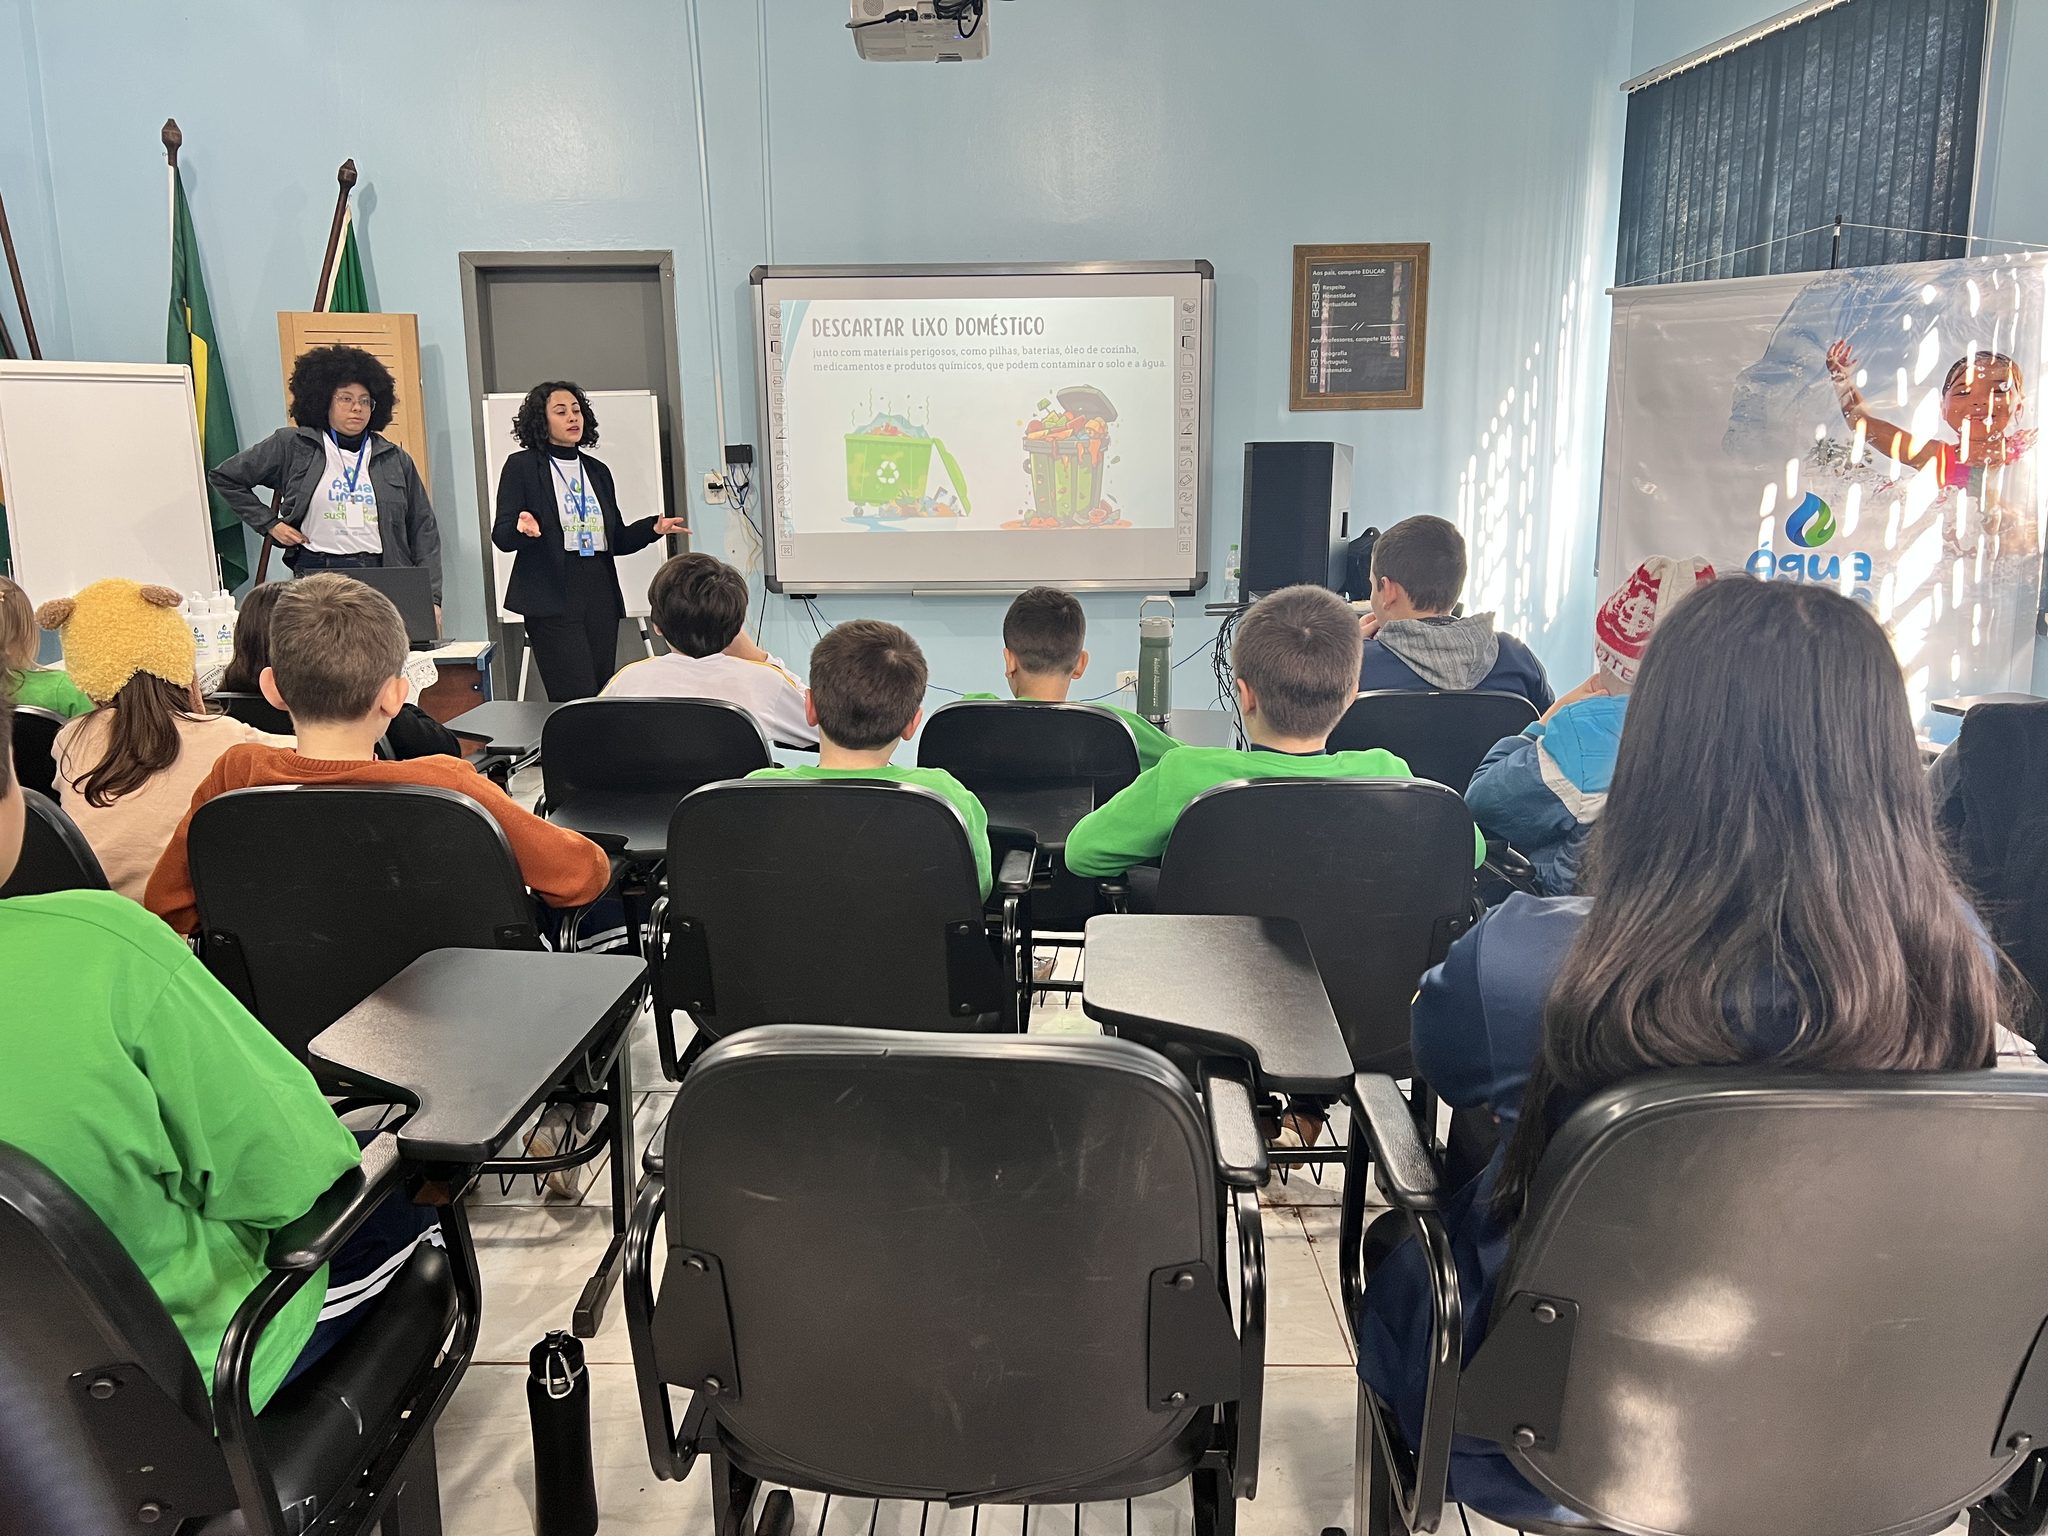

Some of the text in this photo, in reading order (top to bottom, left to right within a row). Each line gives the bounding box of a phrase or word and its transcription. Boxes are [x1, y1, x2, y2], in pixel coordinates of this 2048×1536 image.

[812, 317, 905, 337] DESCARTAR
[812, 344, 1140, 359] junto com materiais perigosos, como pilhas, baterias, óleo de cozinha,
[813, 361, 884, 371] medicamentos
[886, 362, 892, 371] e
[894, 361, 937, 372] produtos
[938, 360, 985, 372] químicos,
[986, 361, 1004, 372] que
[1006, 359, 1039, 370] podem
[1040, 359, 1096, 369] contaminar
[1105, 358, 1126, 368] solo
[1127, 360, 1133, 368] e
[1134, 360, 1140, 368] a
[1745, 541, 1872, 585] Água
